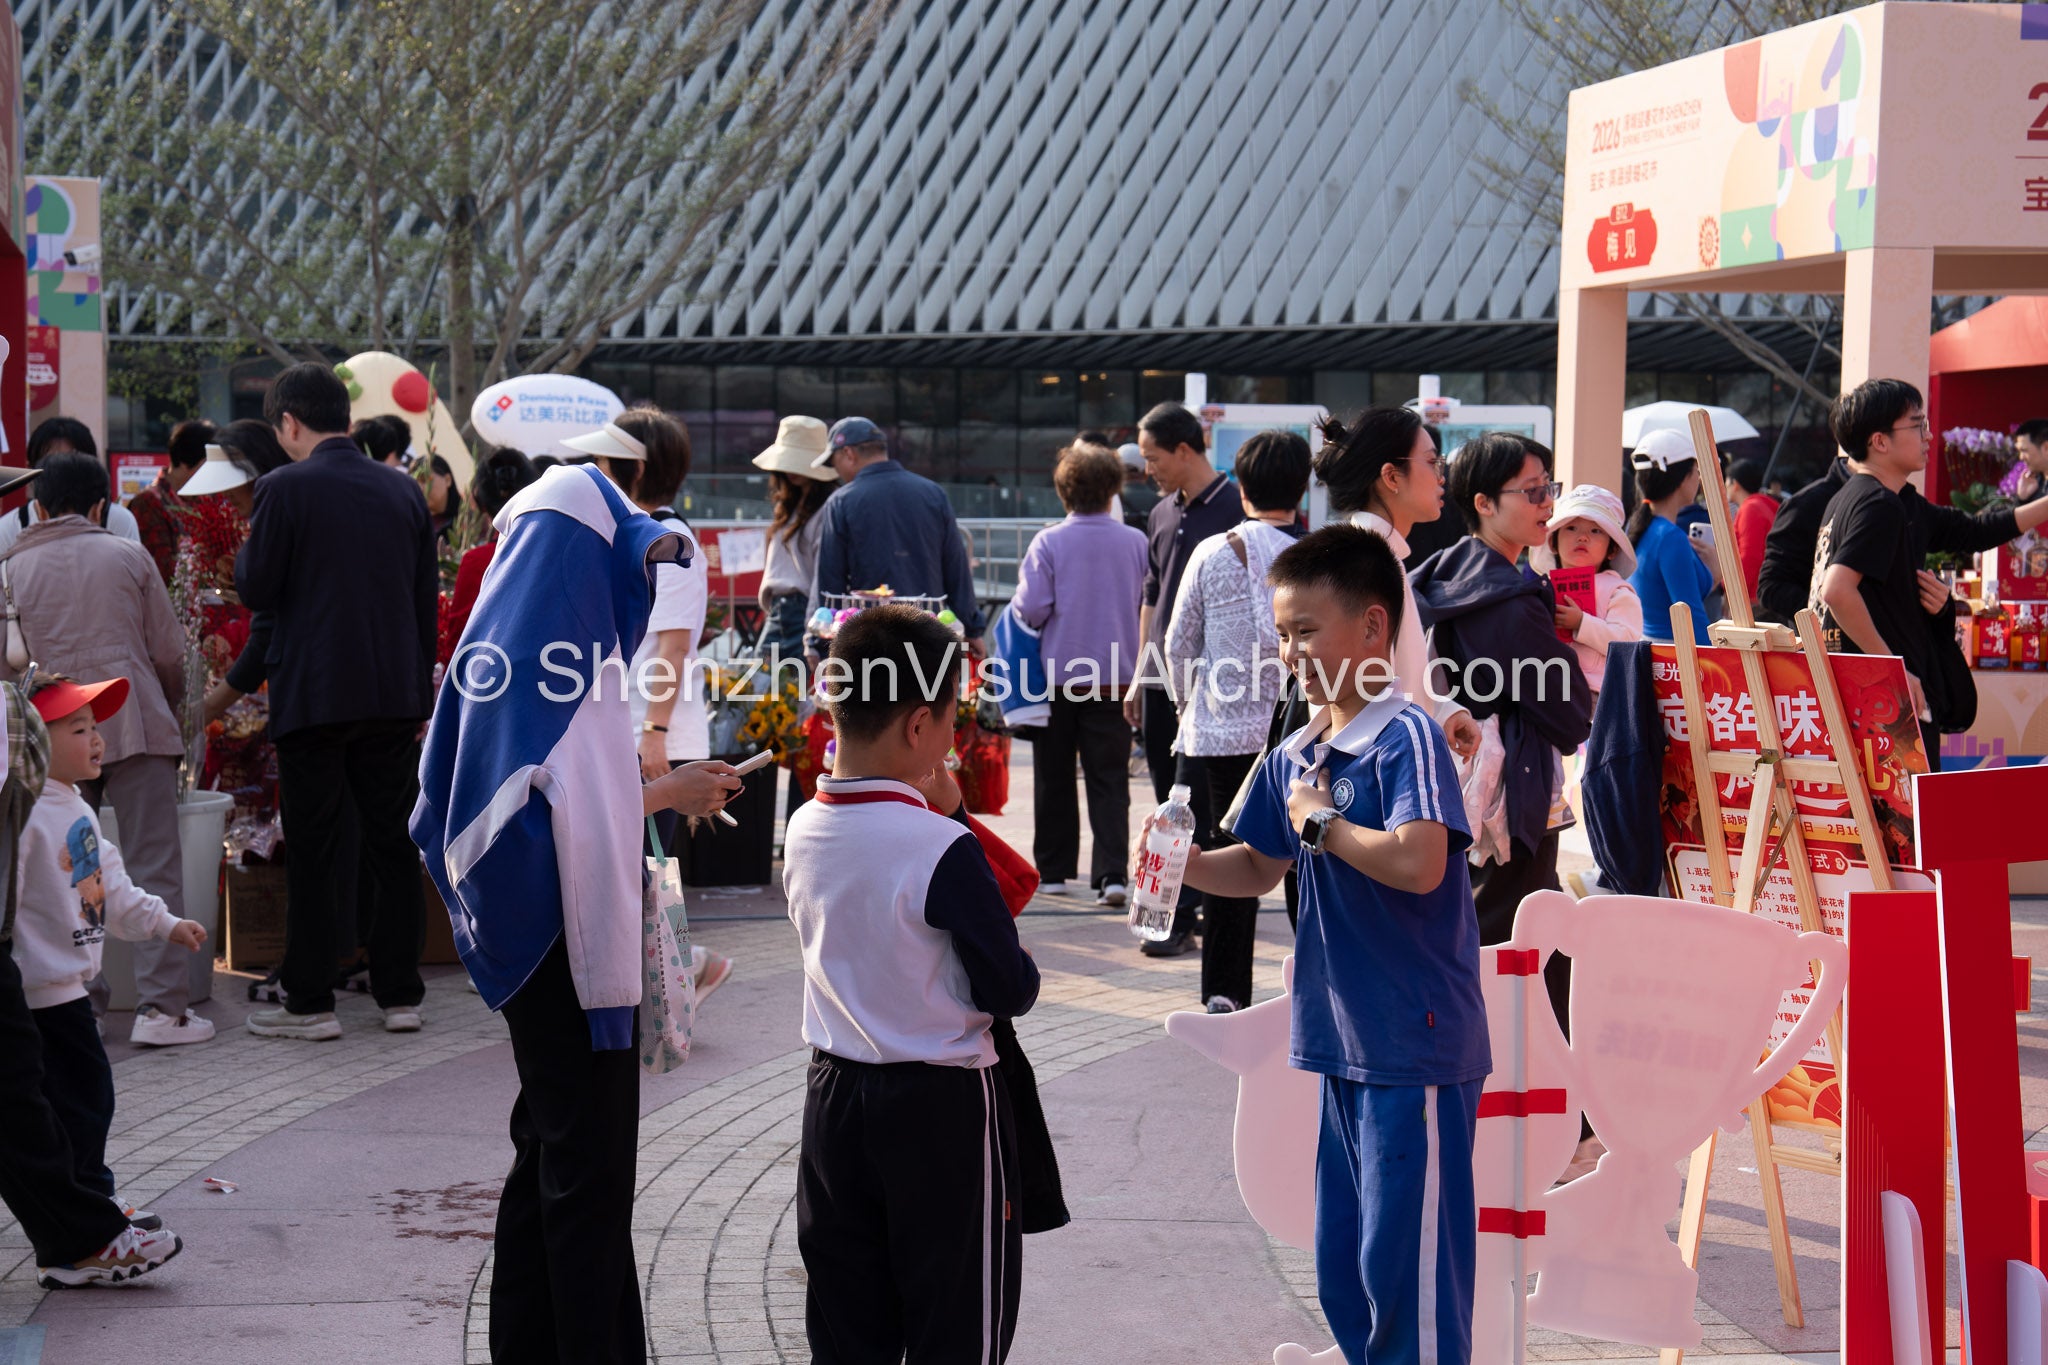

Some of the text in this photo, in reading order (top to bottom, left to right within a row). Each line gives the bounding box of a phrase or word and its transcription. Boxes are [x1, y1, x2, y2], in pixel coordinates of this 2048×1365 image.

[1592, 117, 1620, 153] 2026
[519, 393, 608, 406] Domino's Pizza
[520, 406, 608, 424] 达美乐比萨
